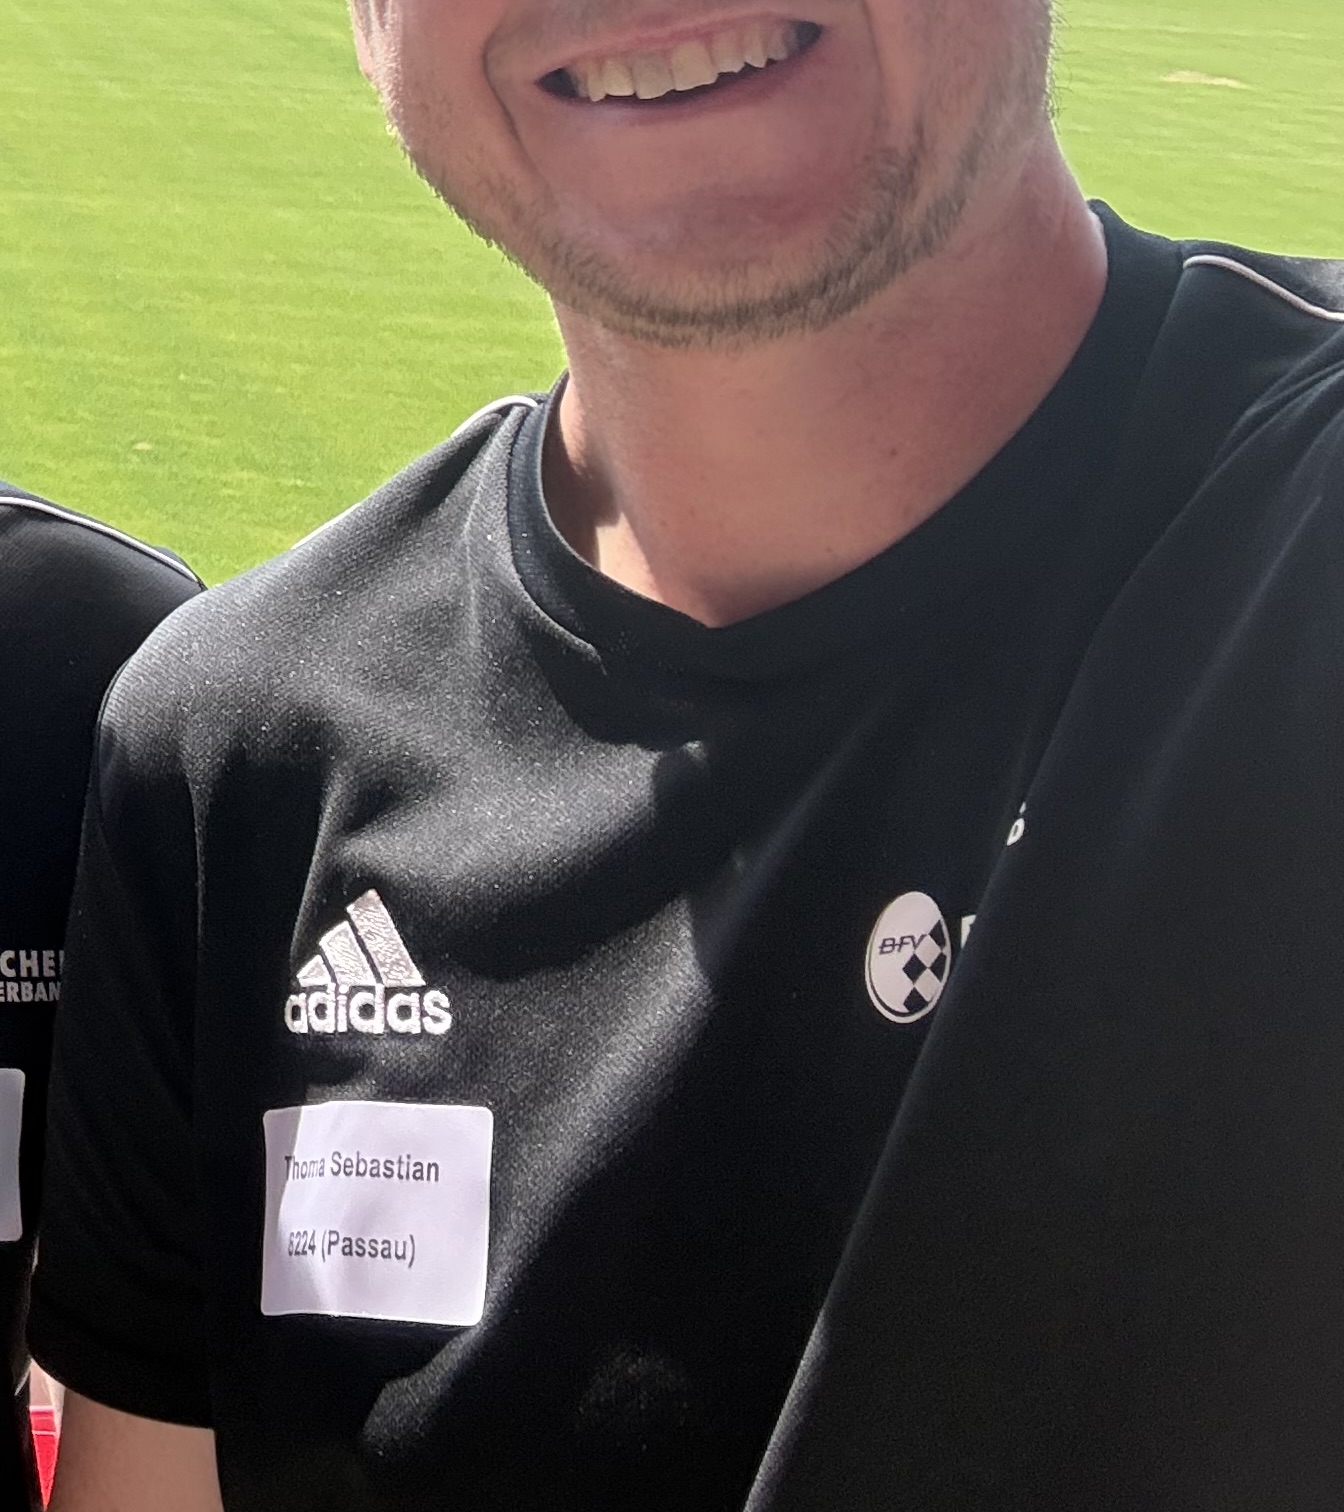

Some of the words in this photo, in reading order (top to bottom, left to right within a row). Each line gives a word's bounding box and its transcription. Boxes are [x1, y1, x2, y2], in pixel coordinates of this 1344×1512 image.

[879, 934, 928, 955] BFV
[284, 983, 452, 1035] adidas
[284, 1155, 325, 1180] Thoma
[330, 1151, 439, 1182] Sebastian
[321, 1229, 415, 1268] (Passau)
